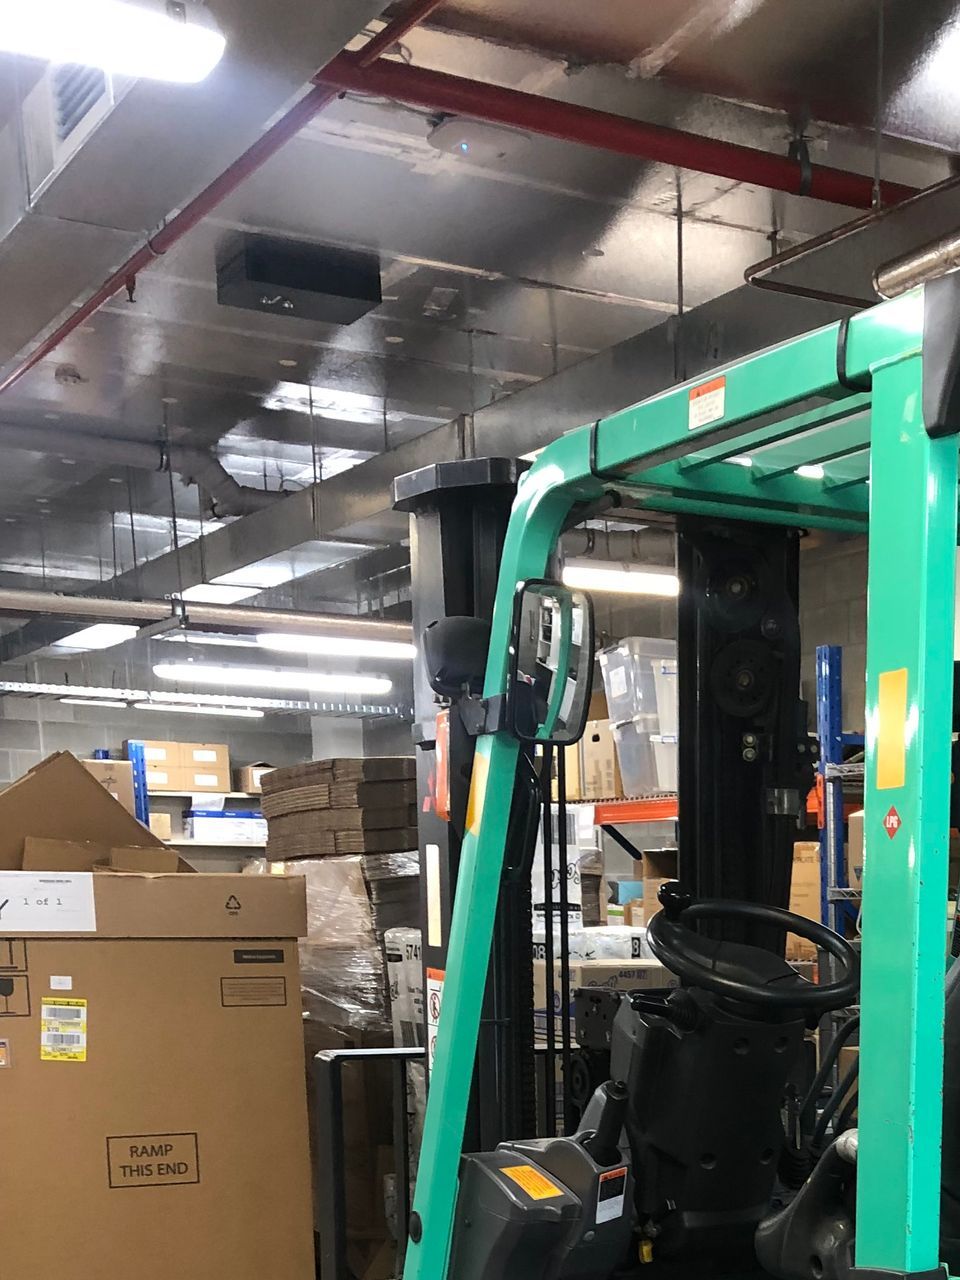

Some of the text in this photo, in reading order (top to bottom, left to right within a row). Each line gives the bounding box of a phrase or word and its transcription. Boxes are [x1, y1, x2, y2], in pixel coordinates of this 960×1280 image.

[886, 815, 898, 828] LPG
[23, 898, 62, 906] 1 of 1
[129, 1144, 173, 1158] RAMP
[119, 1162, 188, 1177] THIS END
